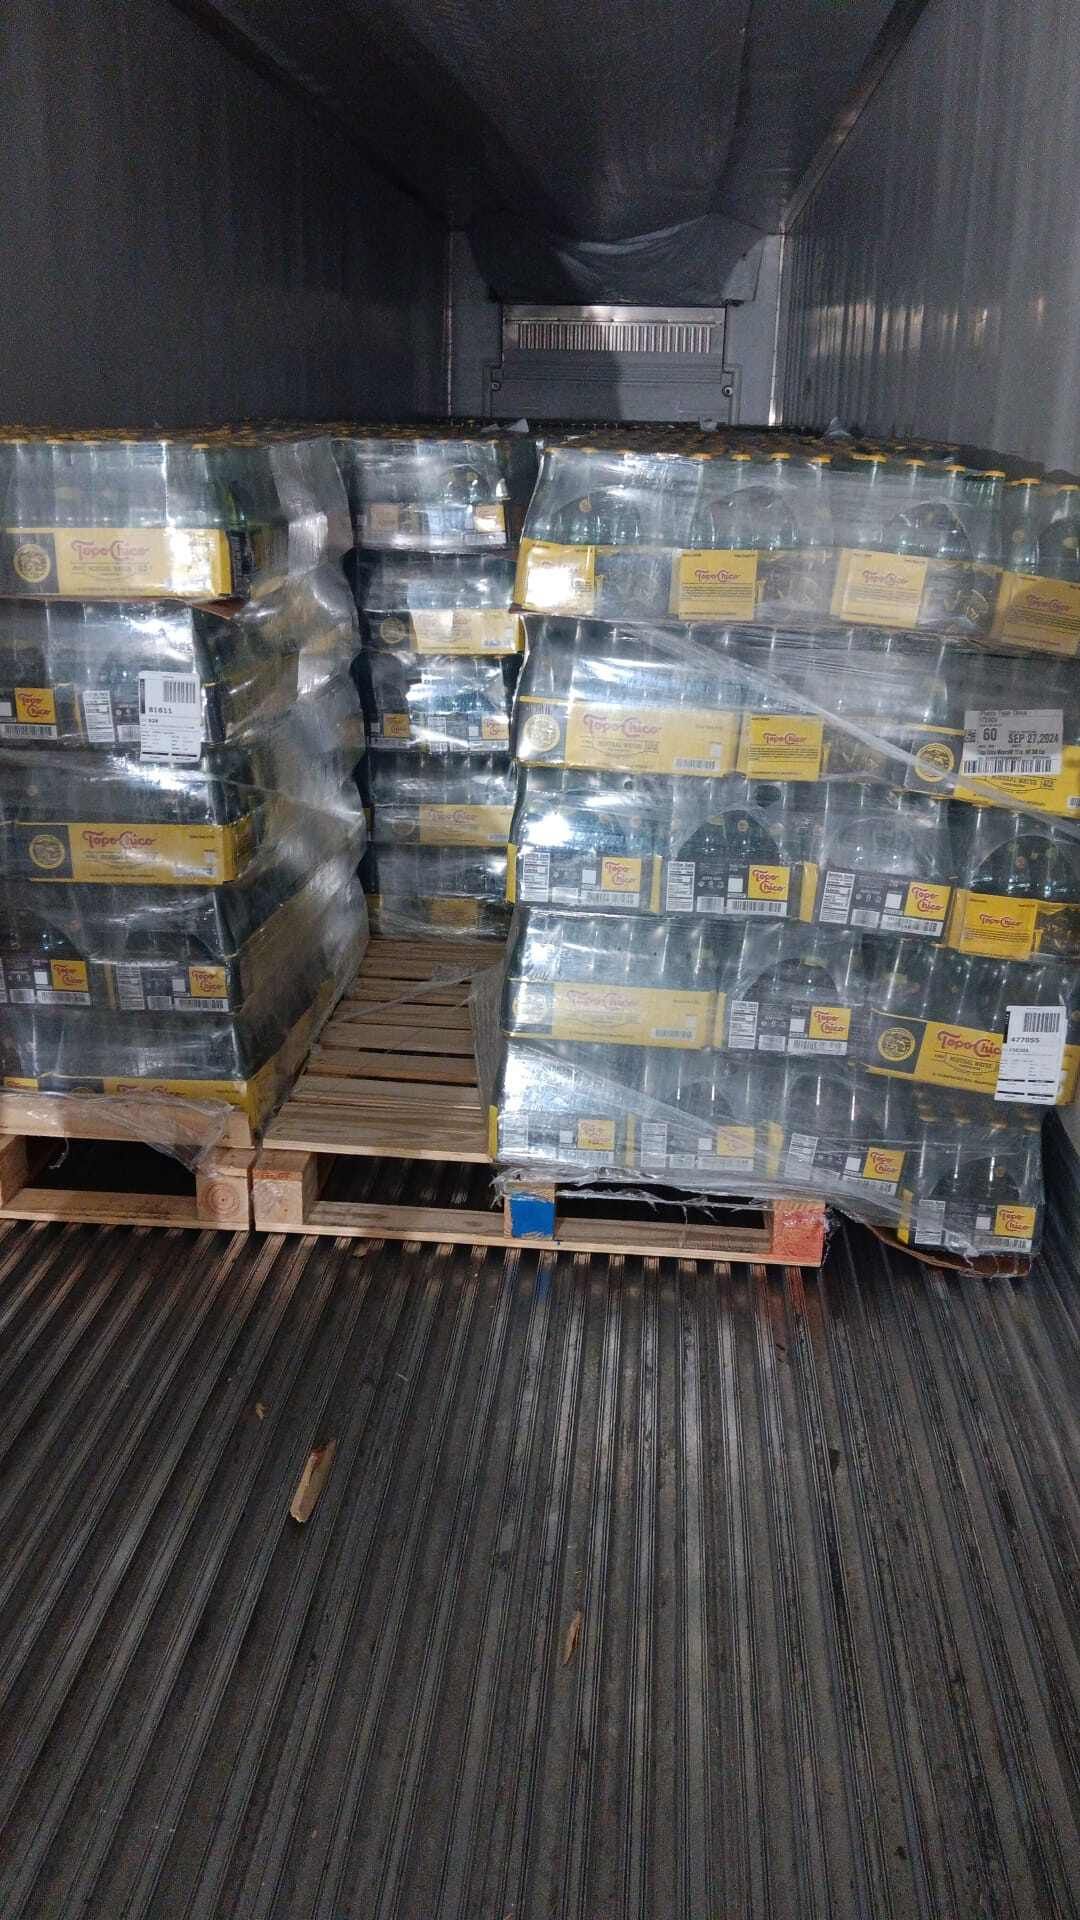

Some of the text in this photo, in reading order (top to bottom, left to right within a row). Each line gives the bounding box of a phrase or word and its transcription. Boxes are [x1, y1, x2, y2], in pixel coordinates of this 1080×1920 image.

[71, 540, 110, 561] Topo
[583, 714, 623, 735] Topo
[622, 717, 661, 737] Chico
[983, 728, 998, 741] 60
[1008, 734, 1026, 744] SEP
[82, 831, 156, 849] Topo Chico
[752, 869, 779, 882] Topo
[760, 880, 786, 894] Chico
[912, 886, 939, 900] Topo
[917, 899, 945, 912] Chico
[814, 1011, 840, 1023] Topo
[821, 1022, 846, 1034] Chico
[937, 1030, 1003, 1057] Topo Chic
[871, 1152, 896, 1163] Topo
[875, 1162, 898, 1174] Chico
[1000, 1209, 1024, 1220] Topo
[1006, 1220, 1032, 1232] Chico
